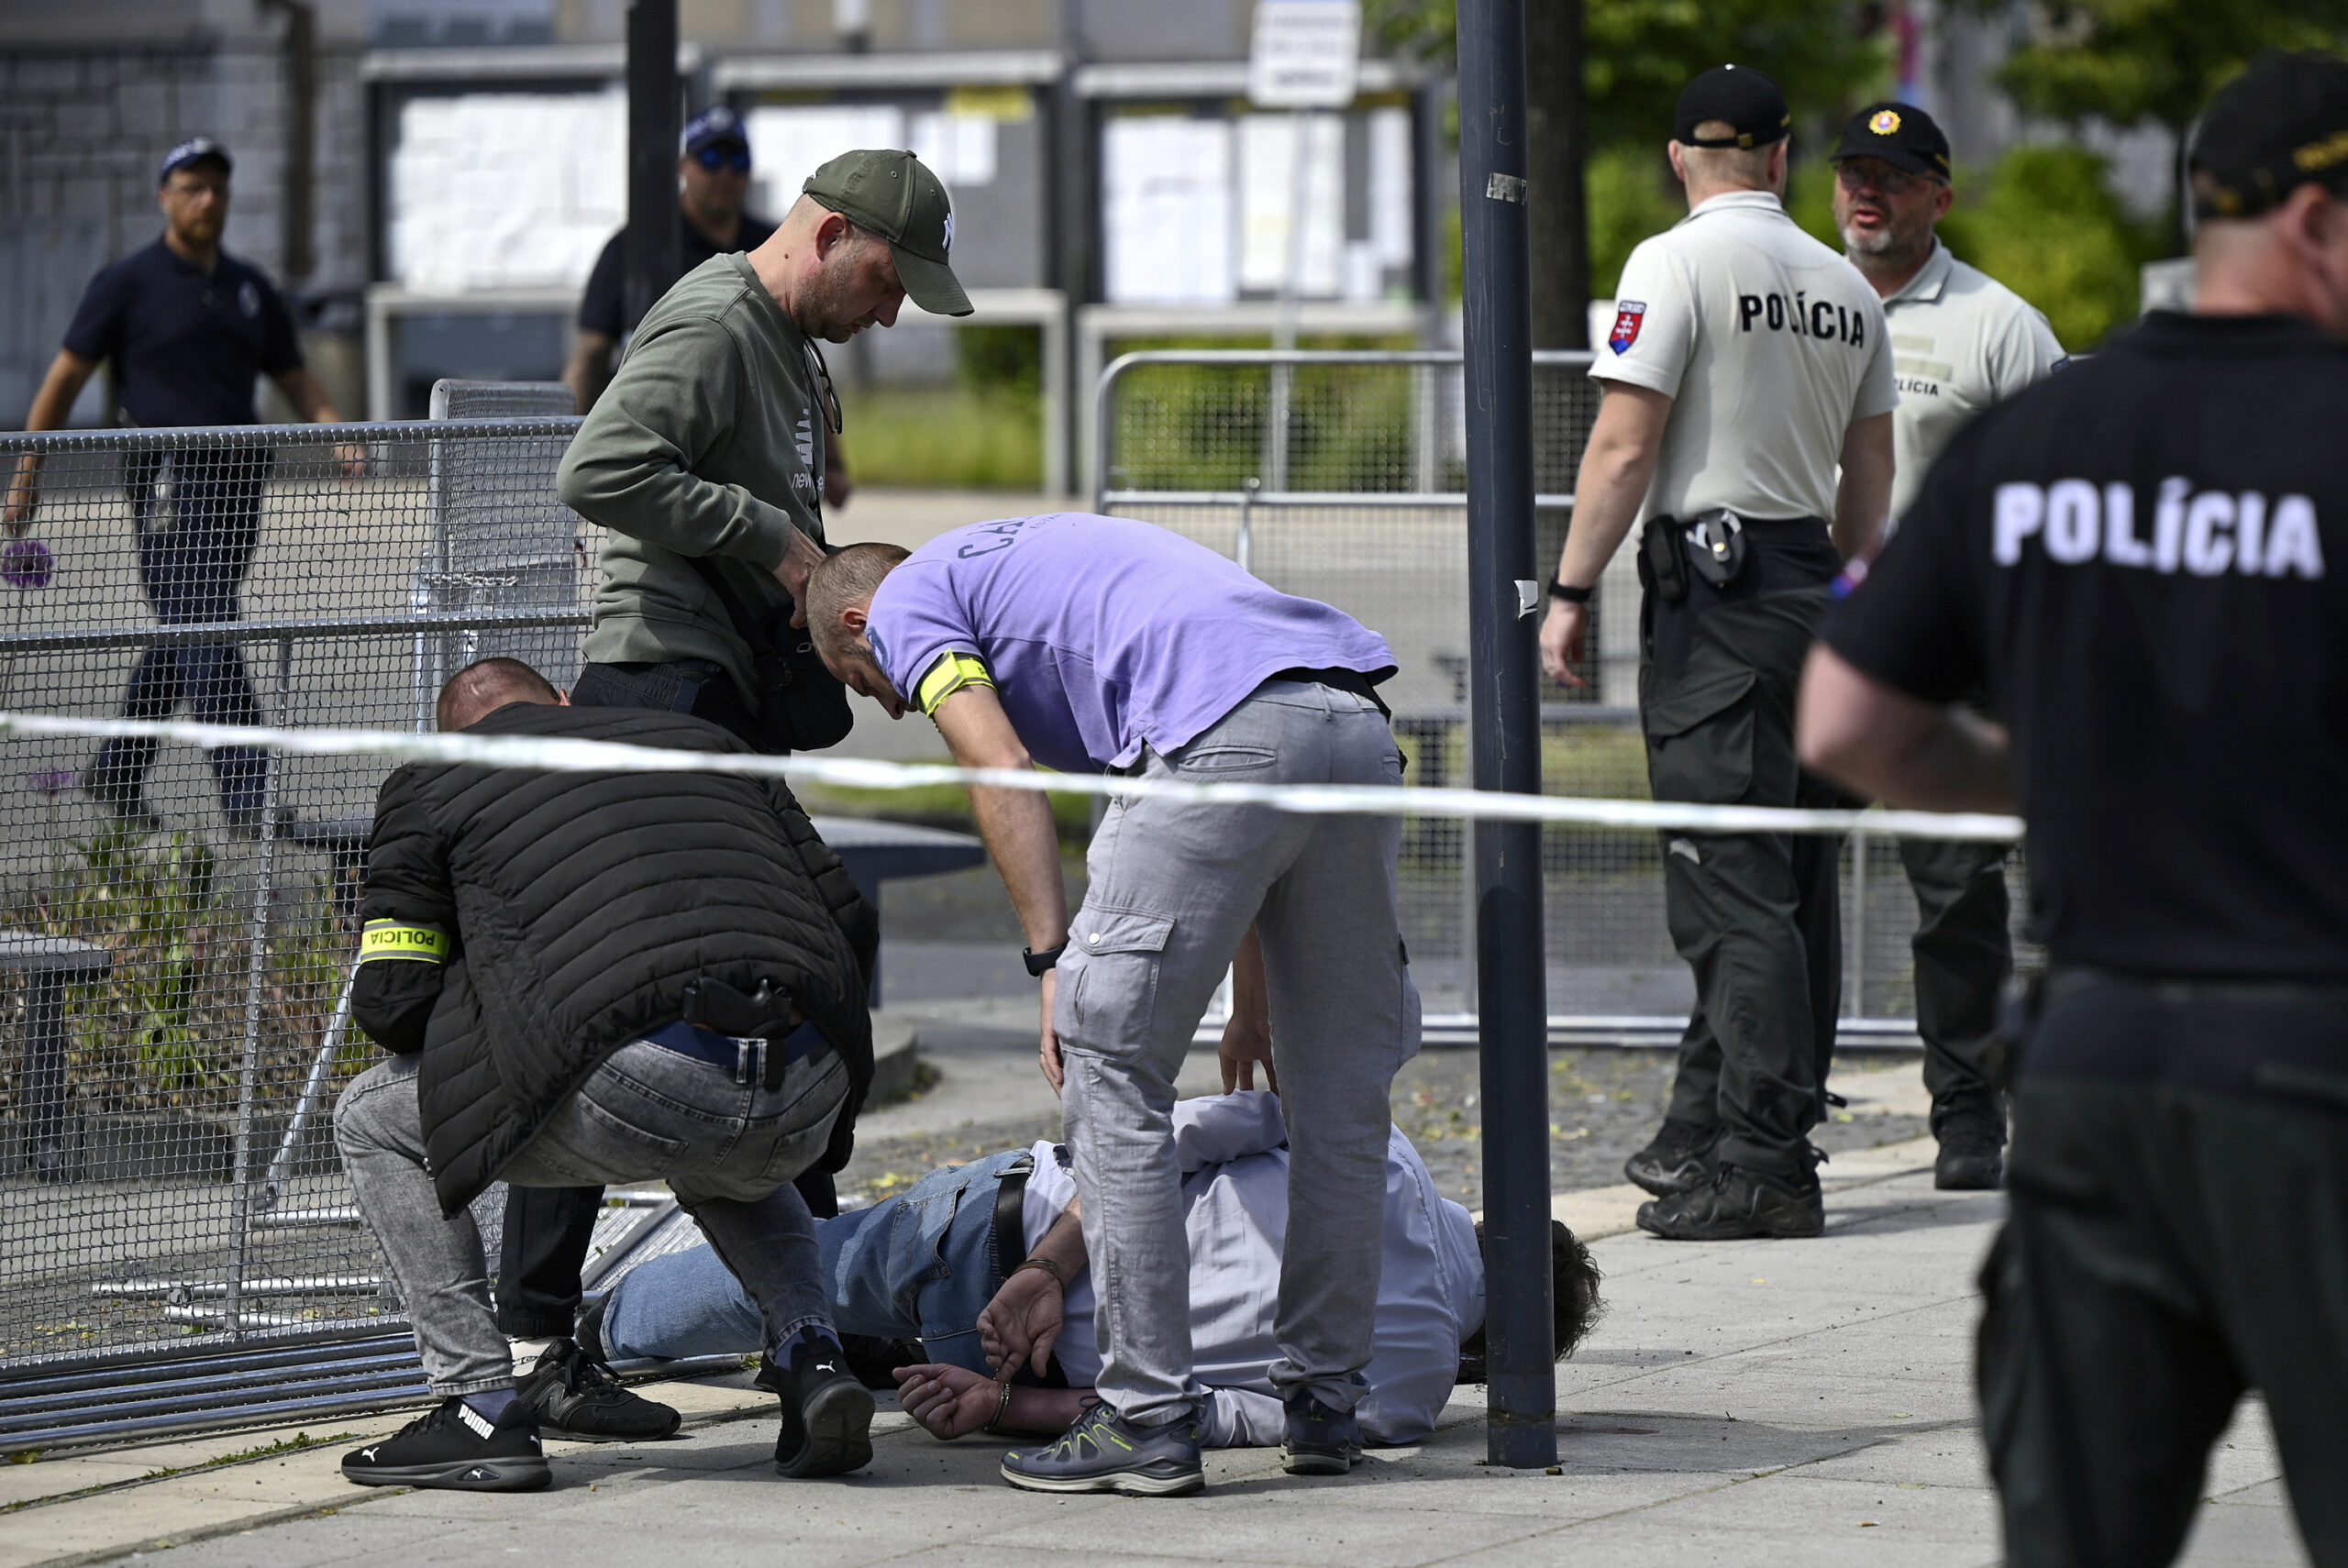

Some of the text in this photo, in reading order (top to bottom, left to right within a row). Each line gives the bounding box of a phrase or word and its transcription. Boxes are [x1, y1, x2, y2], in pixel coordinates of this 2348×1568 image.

[1739, 291, 1865, 349] POLÍCIA
[1893, 377, 1939, 397] LÍCIA
[1992, 474, 2326, 580] POLÍCIA
[371, 930, 436, 947] POLÍCIA
[458, 1403, 495, 1440] PUMA
